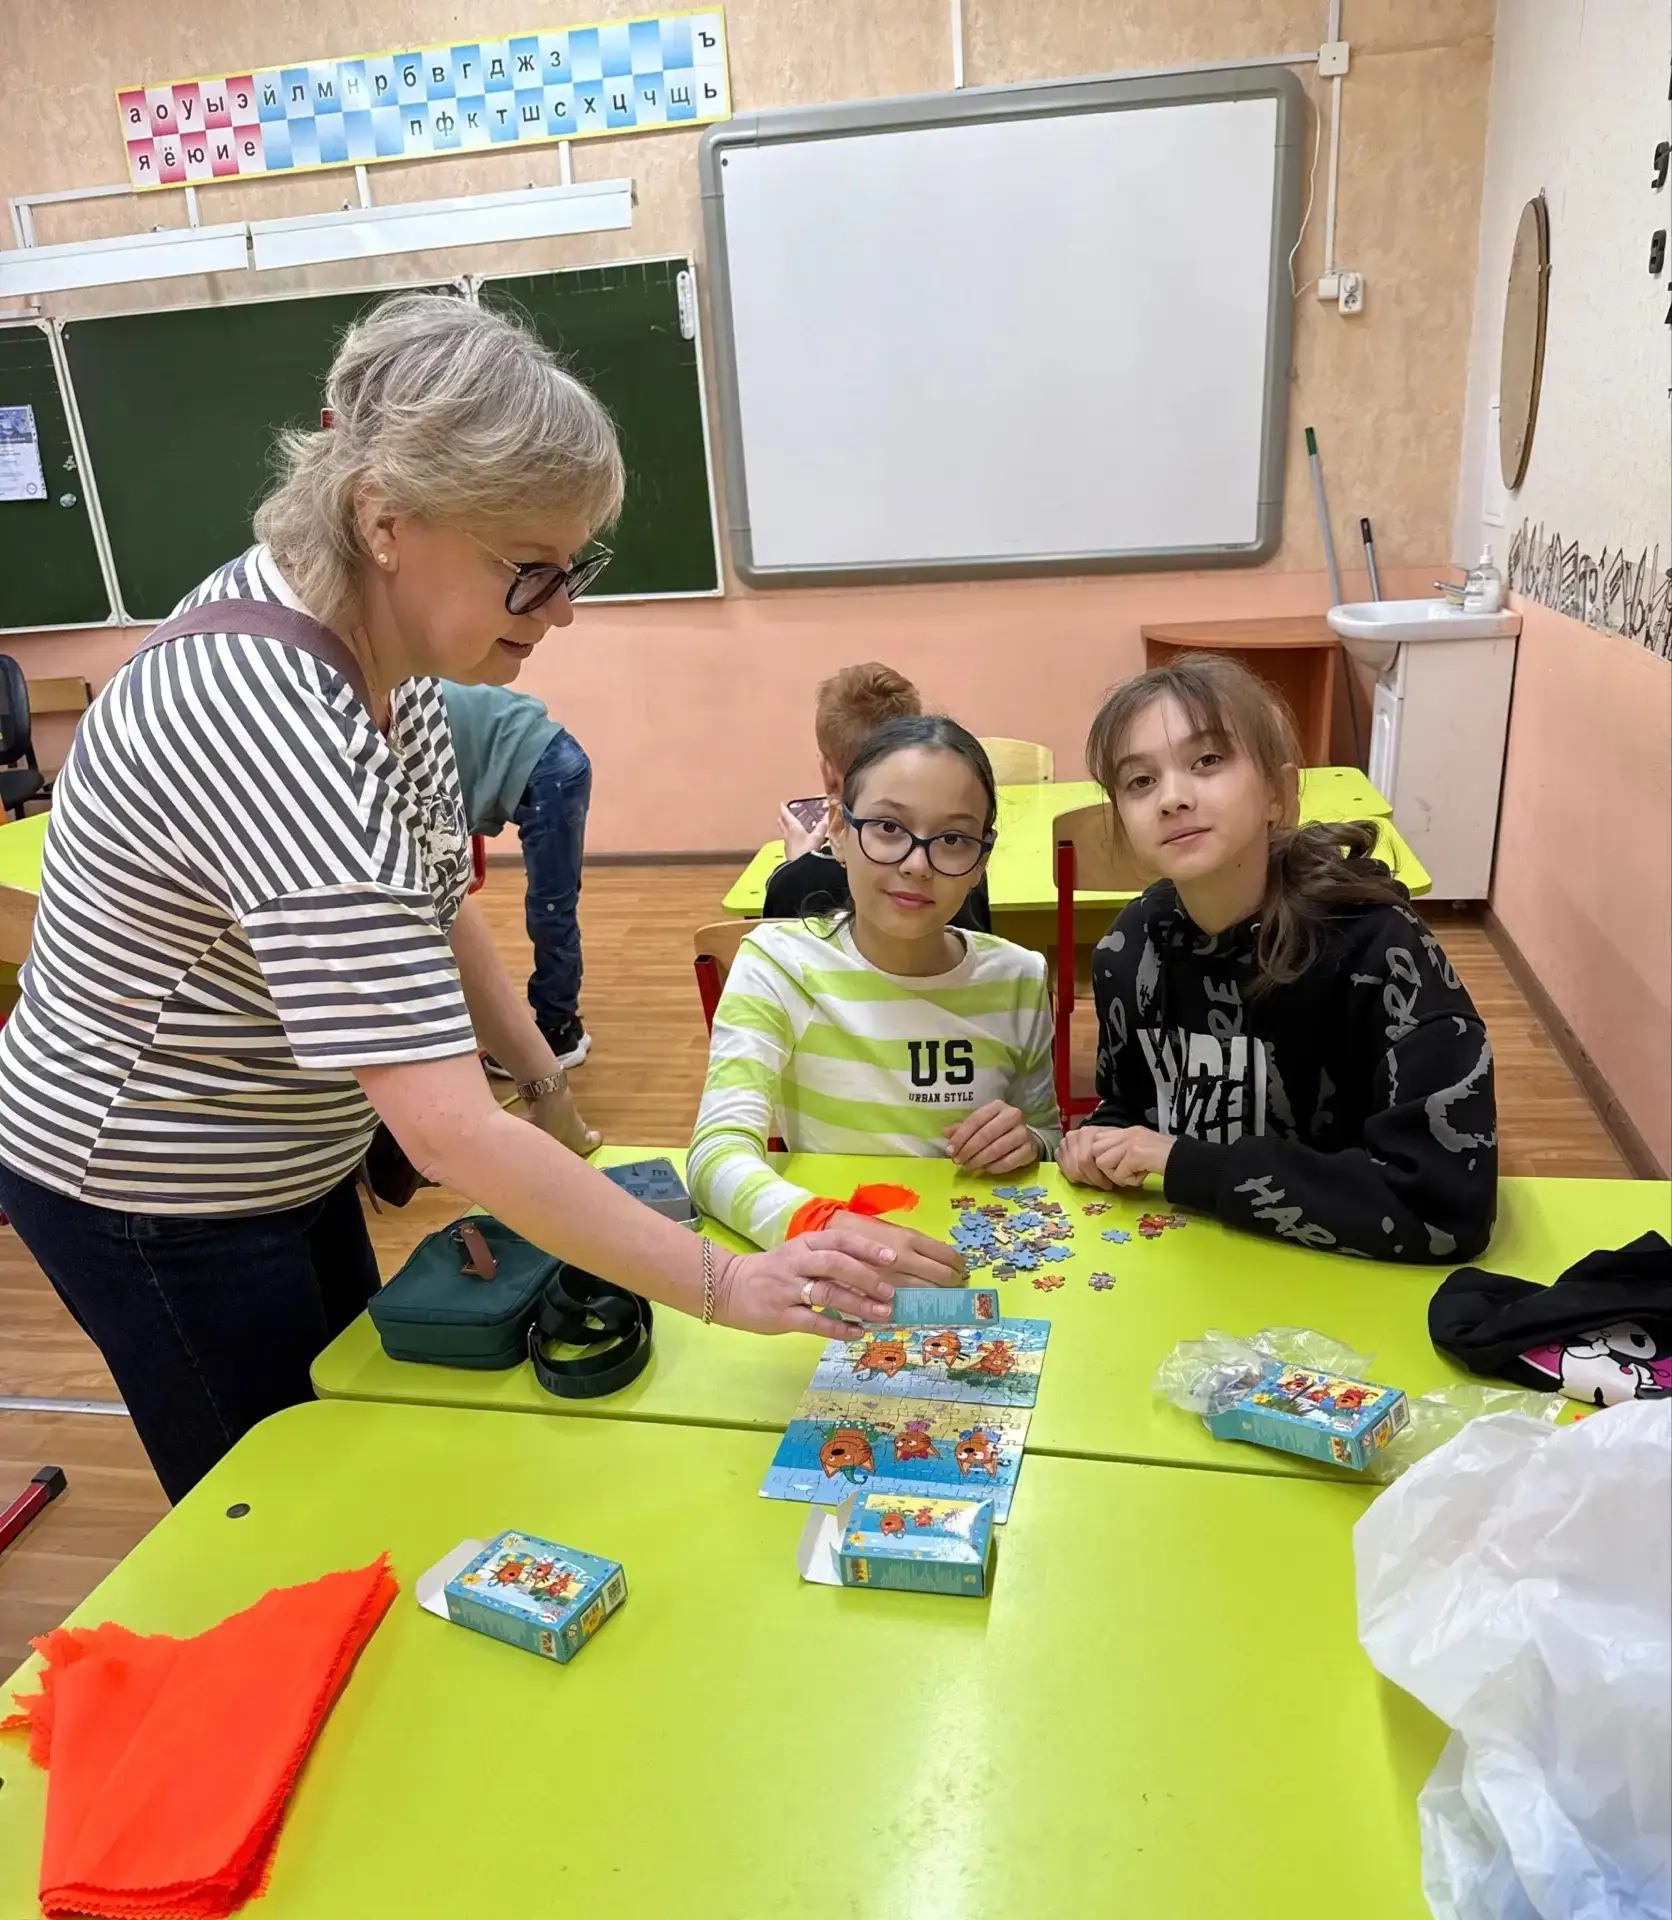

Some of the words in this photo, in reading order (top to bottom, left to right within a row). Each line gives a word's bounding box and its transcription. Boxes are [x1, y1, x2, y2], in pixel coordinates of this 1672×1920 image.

[129, 109, 141, 123] а
[157, 104, 168, 119] о
[182, 98, 193, 120] у
[207, 96, 225, 113] ы
[237, 93, 248, 109] э
[263, 84, 277, 105] й
[291, 85, 305, 101] л
[318, 82, 333, 99] м
[347, 78, 359, 94] н
[375, 74, 388, 95] р
[403, 66, 416, 87] б
[432, 67, 444, 83] в
[463, 63, 472, 79] г
[490, 59, 505, 79] д
[517, 55, 534, 72] ж
[551, 51, 561, 67] з
[699, 32, 716, 48] ъ
[139, 155, 151, 170] я
[164, 147, 175, 167] ё
[188, 148, 204, 164] ю
[217, 143, 229, 160] и
[244, 141, 256, 157] е
[410, 120, 422, 136] п
[436, 111, 454, 136] ф
[468, 113, 478, 128] к
[496, 109, 507, 124] т
[522, 106, 540, 122] ш
[554, 102, 566, 117] с
[584, 98, 596, 113] х
[613, 94, 627, 113] ц
[644, 90, 656, 106] ч
[670, 87, 690, 106] щ
[704, 83, 717, 99] ь
[1651, 141, 1670, 189] 9
[1649, 229, 1666, 273] 8
[908, 1040, 974, 1087] US
[909, 1093, 940, 1103] URBAN
[944, 1092, 974, 1102] STYLE
